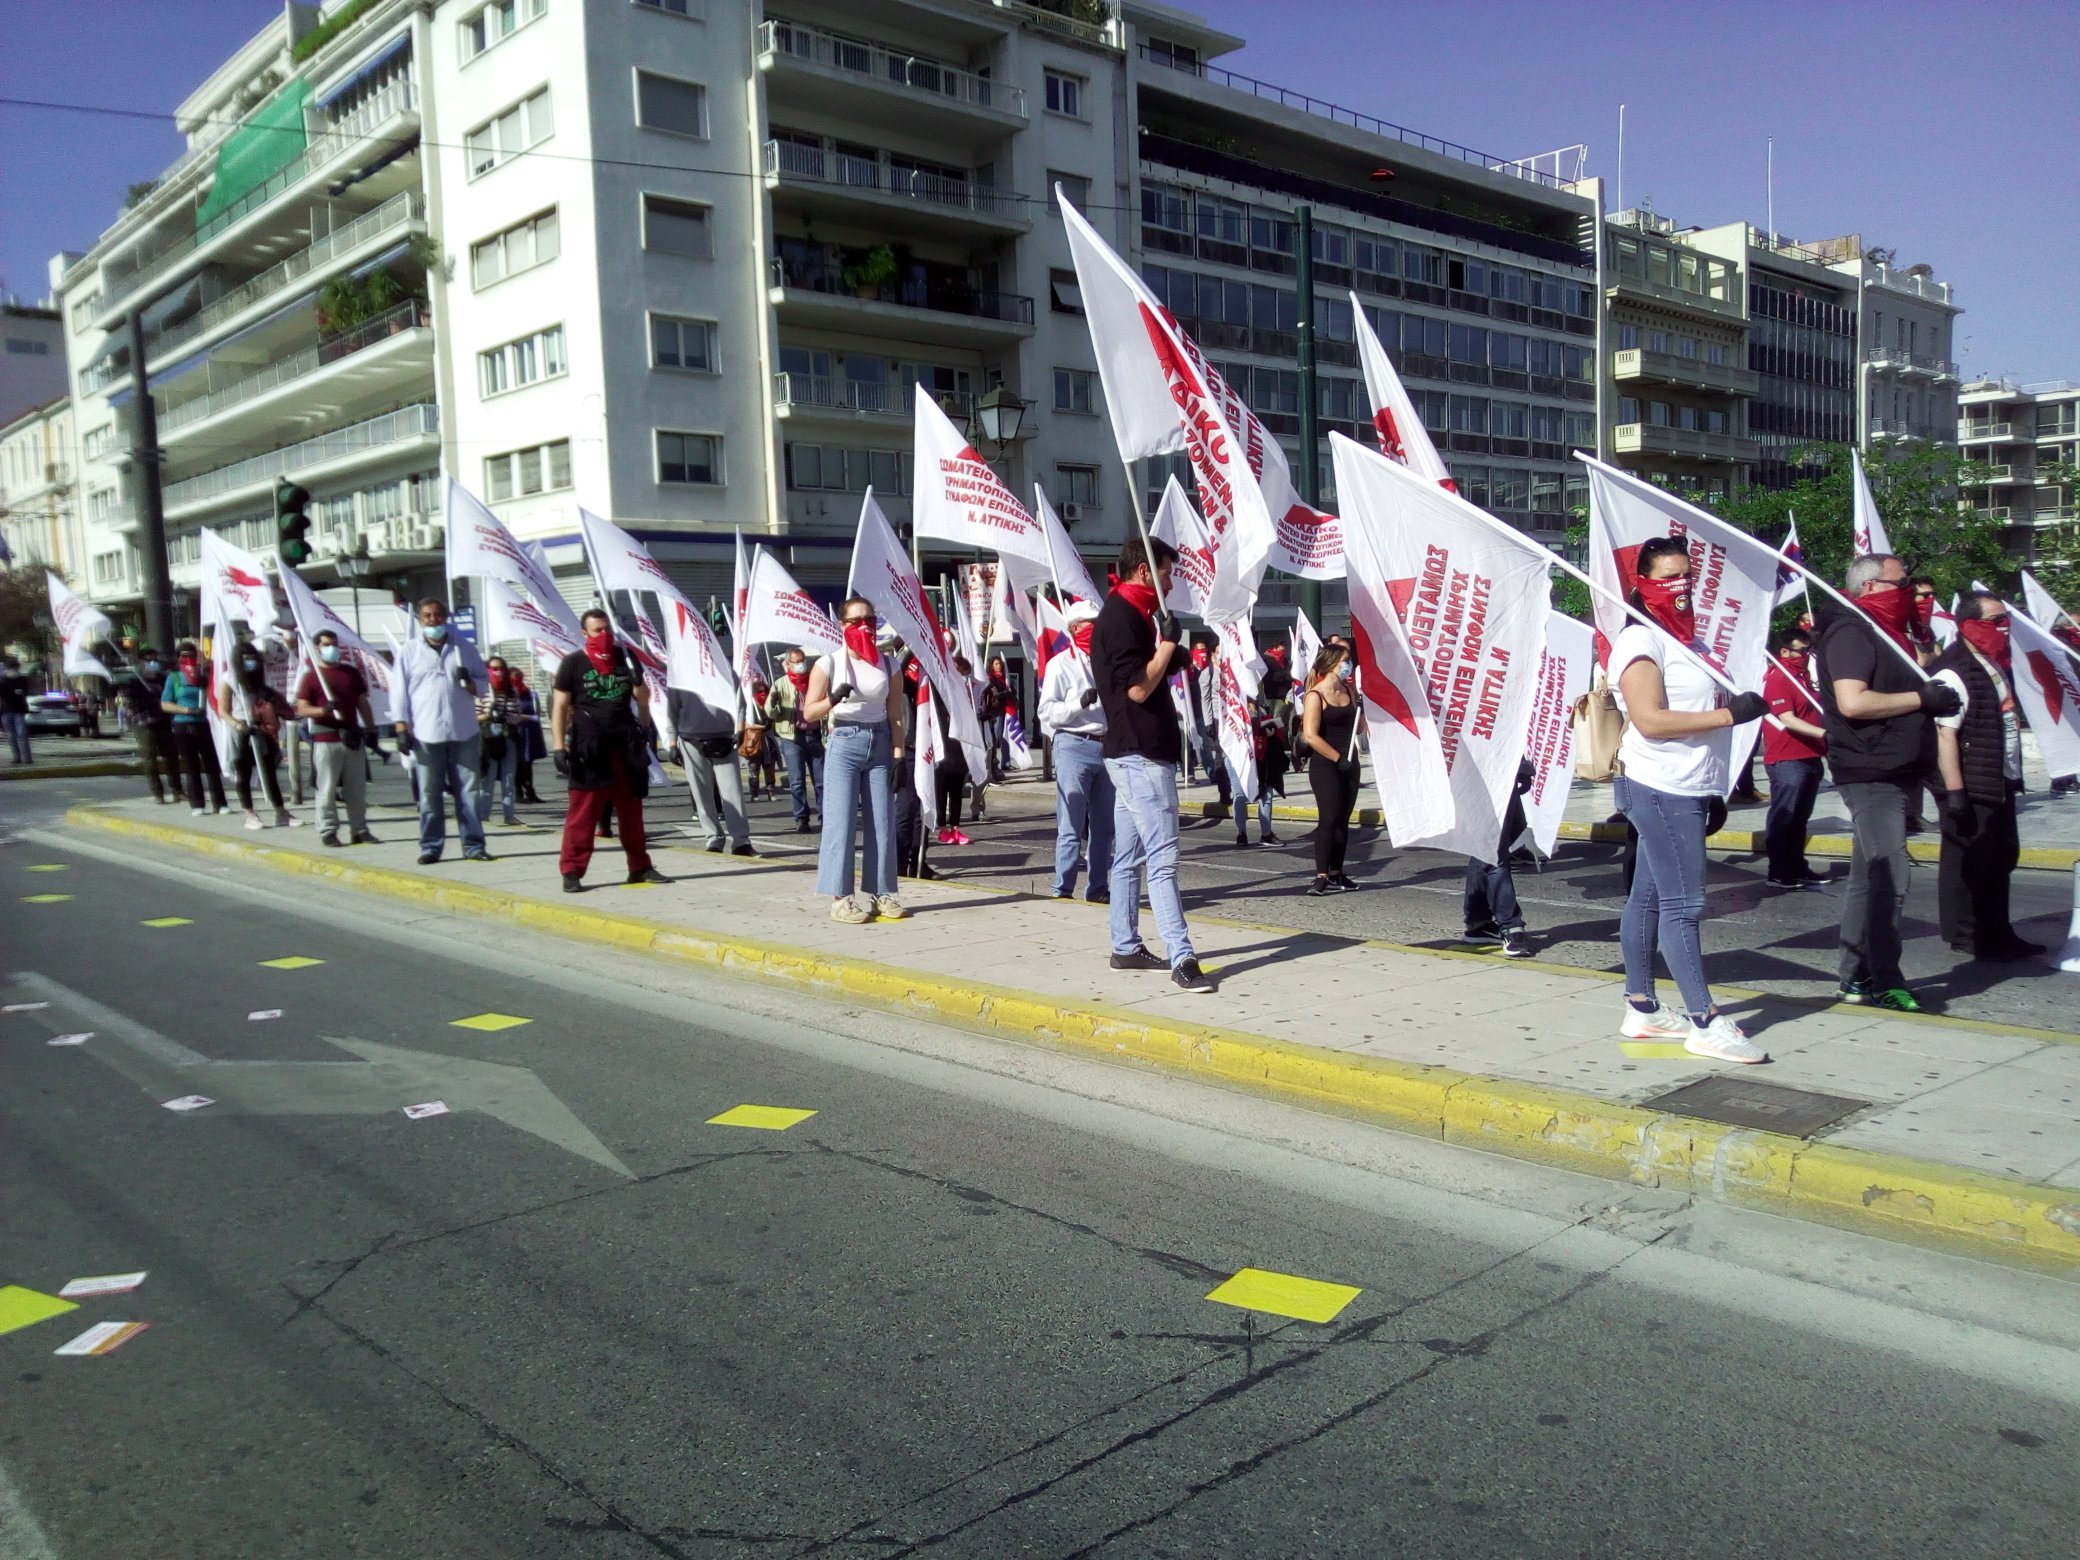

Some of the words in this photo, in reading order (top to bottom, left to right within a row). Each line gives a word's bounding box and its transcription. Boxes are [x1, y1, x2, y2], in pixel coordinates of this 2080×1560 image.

[945, 489, 985, 507] ΣΥΝΑΦΩΝ
[980, 513, 1026, 534] ΑΤΤΙΚΗΣ
[1297, 559, 1326, 568] ΑΤΤΙΚΗΣ
[774, 609, 821, 627] ΣΥΝΑΦΩΝ
